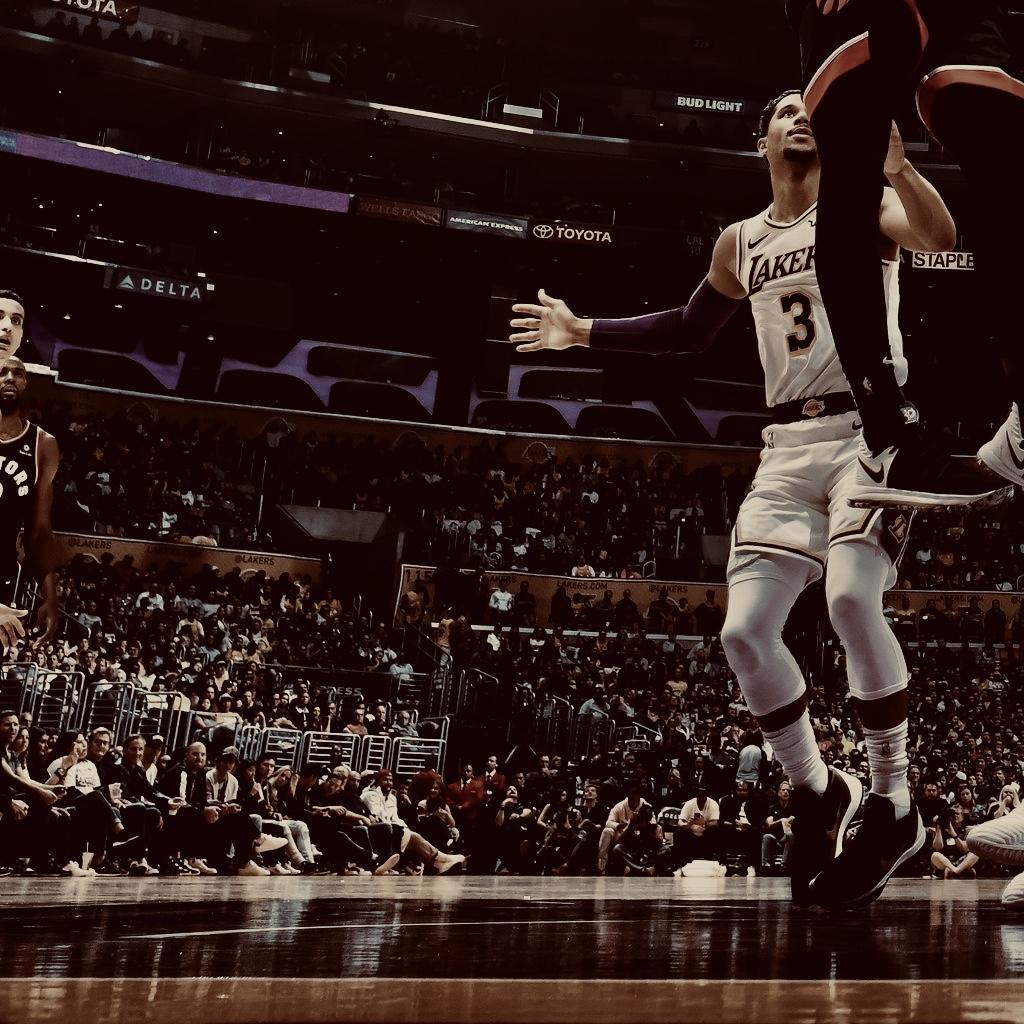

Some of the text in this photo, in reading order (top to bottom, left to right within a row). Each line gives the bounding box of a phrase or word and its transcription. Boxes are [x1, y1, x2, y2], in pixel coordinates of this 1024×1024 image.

[676, 95, 743, 113] BUD LIGHT
[449, 216, 524, 233] AMERICAN EXPRESS
[556, 226, 612, 243] TOYOTA
[913, 252, 975, 268] STAPLE
[749, 244, 817, 295] LAKER
[140, 277, 202, 300] DELTA
[780, 291, 816, 353] 3
[67, 537, 112, 551] @LAKERS
[234, 554, 275, 566] @LAKERS
[556, 580, 608, 592] LAKERS.COM
